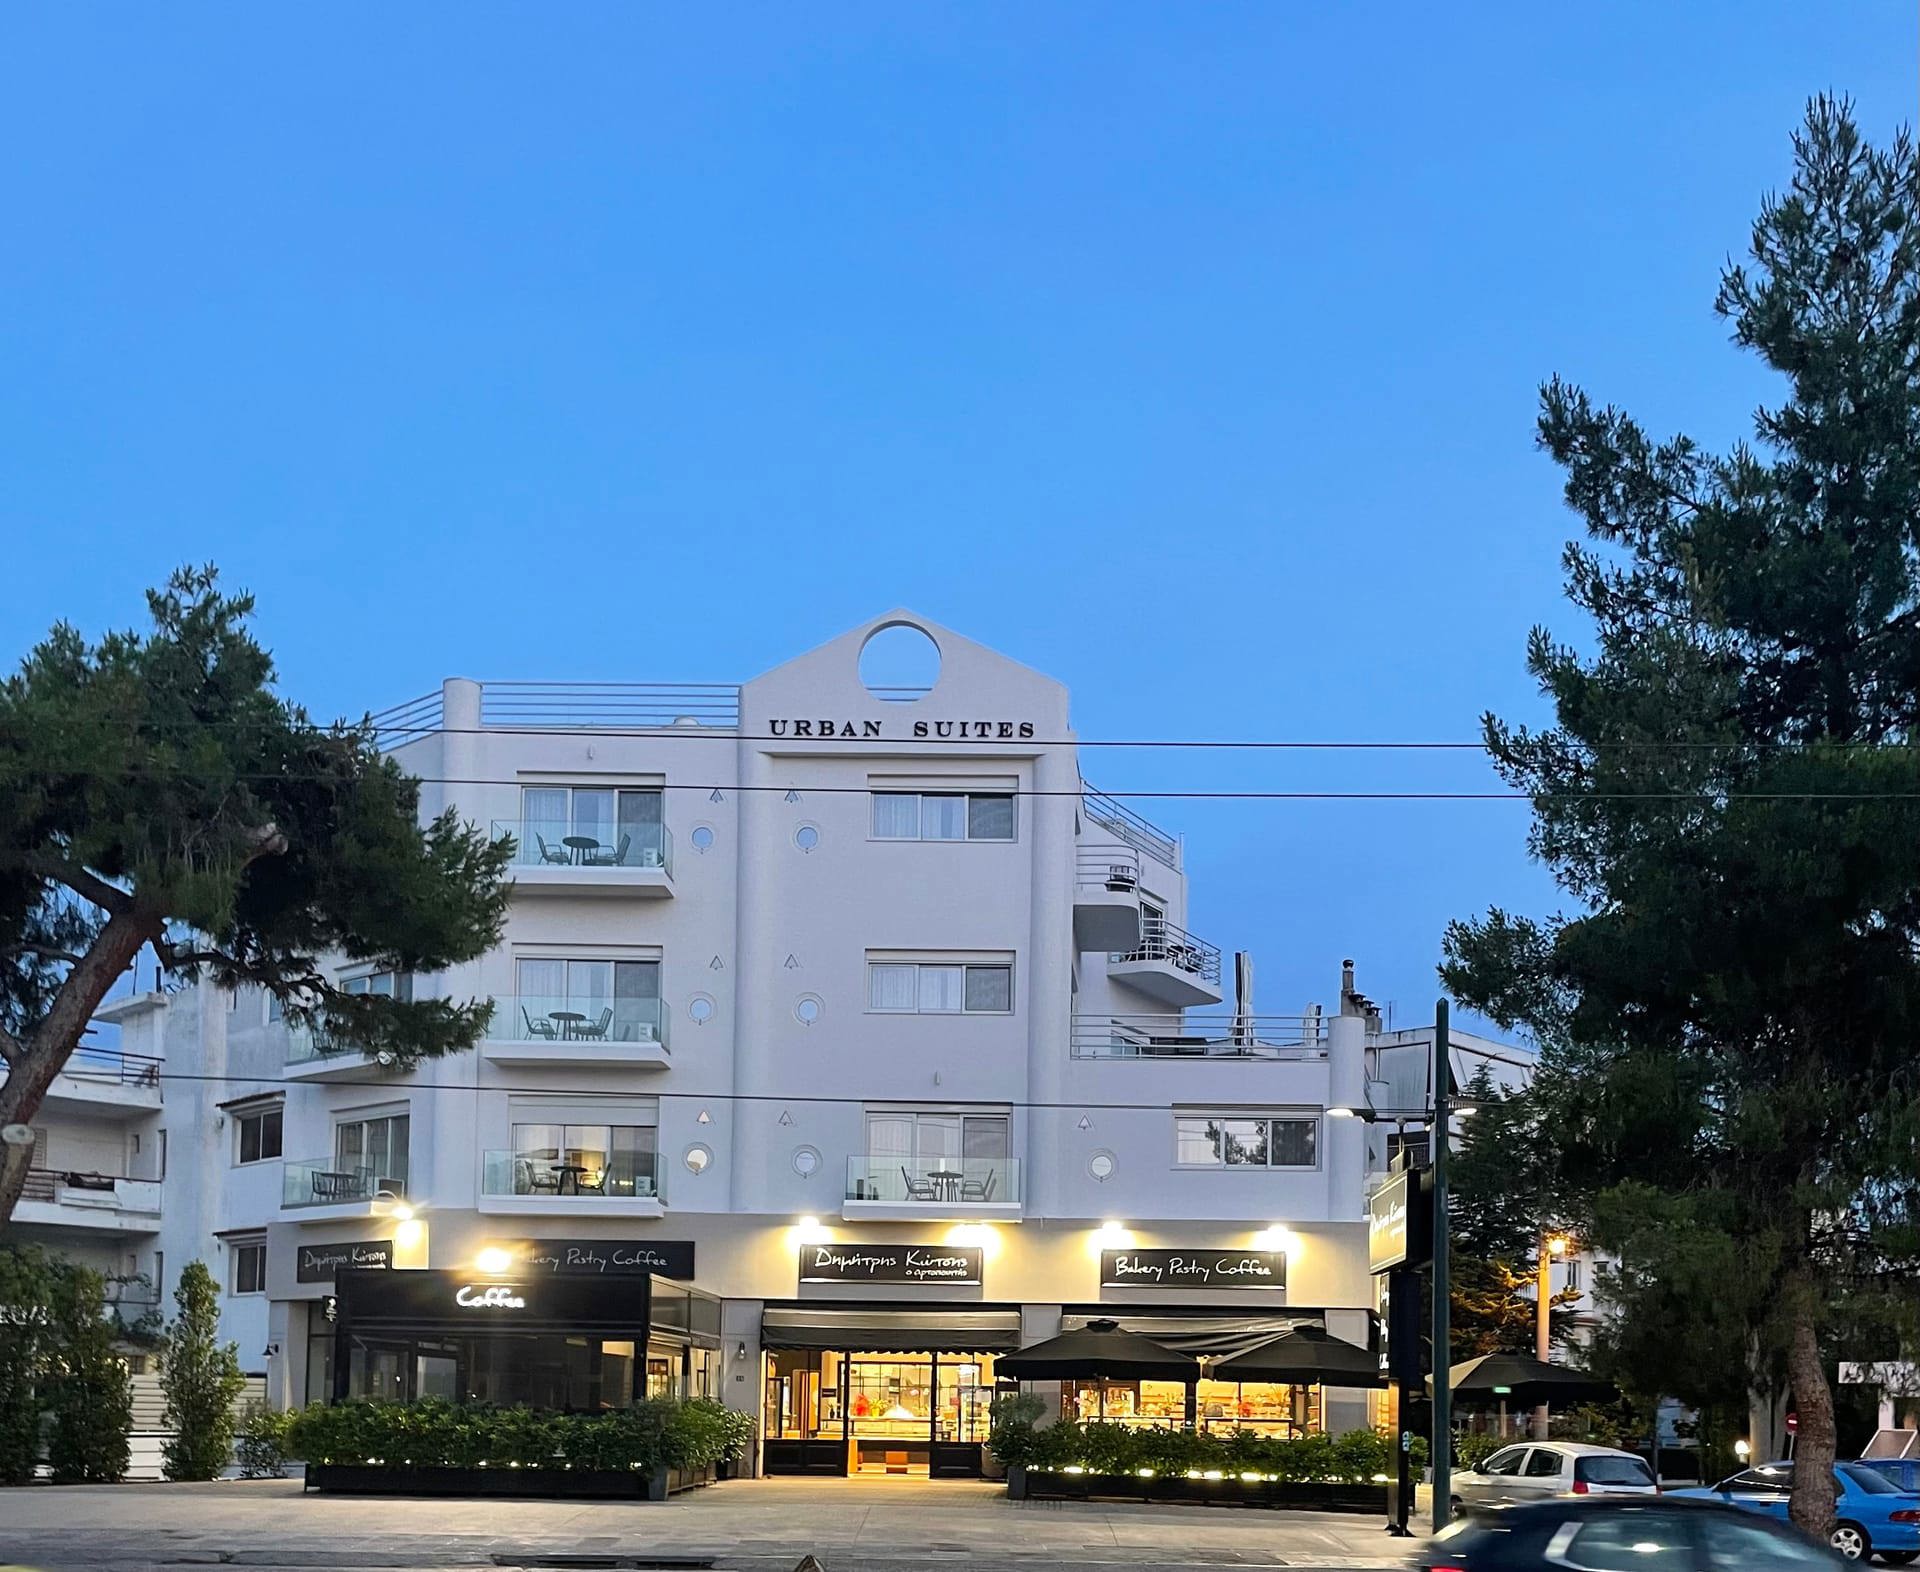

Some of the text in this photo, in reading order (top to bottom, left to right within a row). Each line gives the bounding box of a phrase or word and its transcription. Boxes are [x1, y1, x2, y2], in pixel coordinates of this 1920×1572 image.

[769, 719, 1035, 738] URBAN SUITES
[566, 1247, 607, 1273] Pastry
[612, 1249, 669, 1267] Coffee
[1115, 1256, 1273, 1283] Bakery Pastry Coffee
[456, 1286, 525, 1308] Coffee
